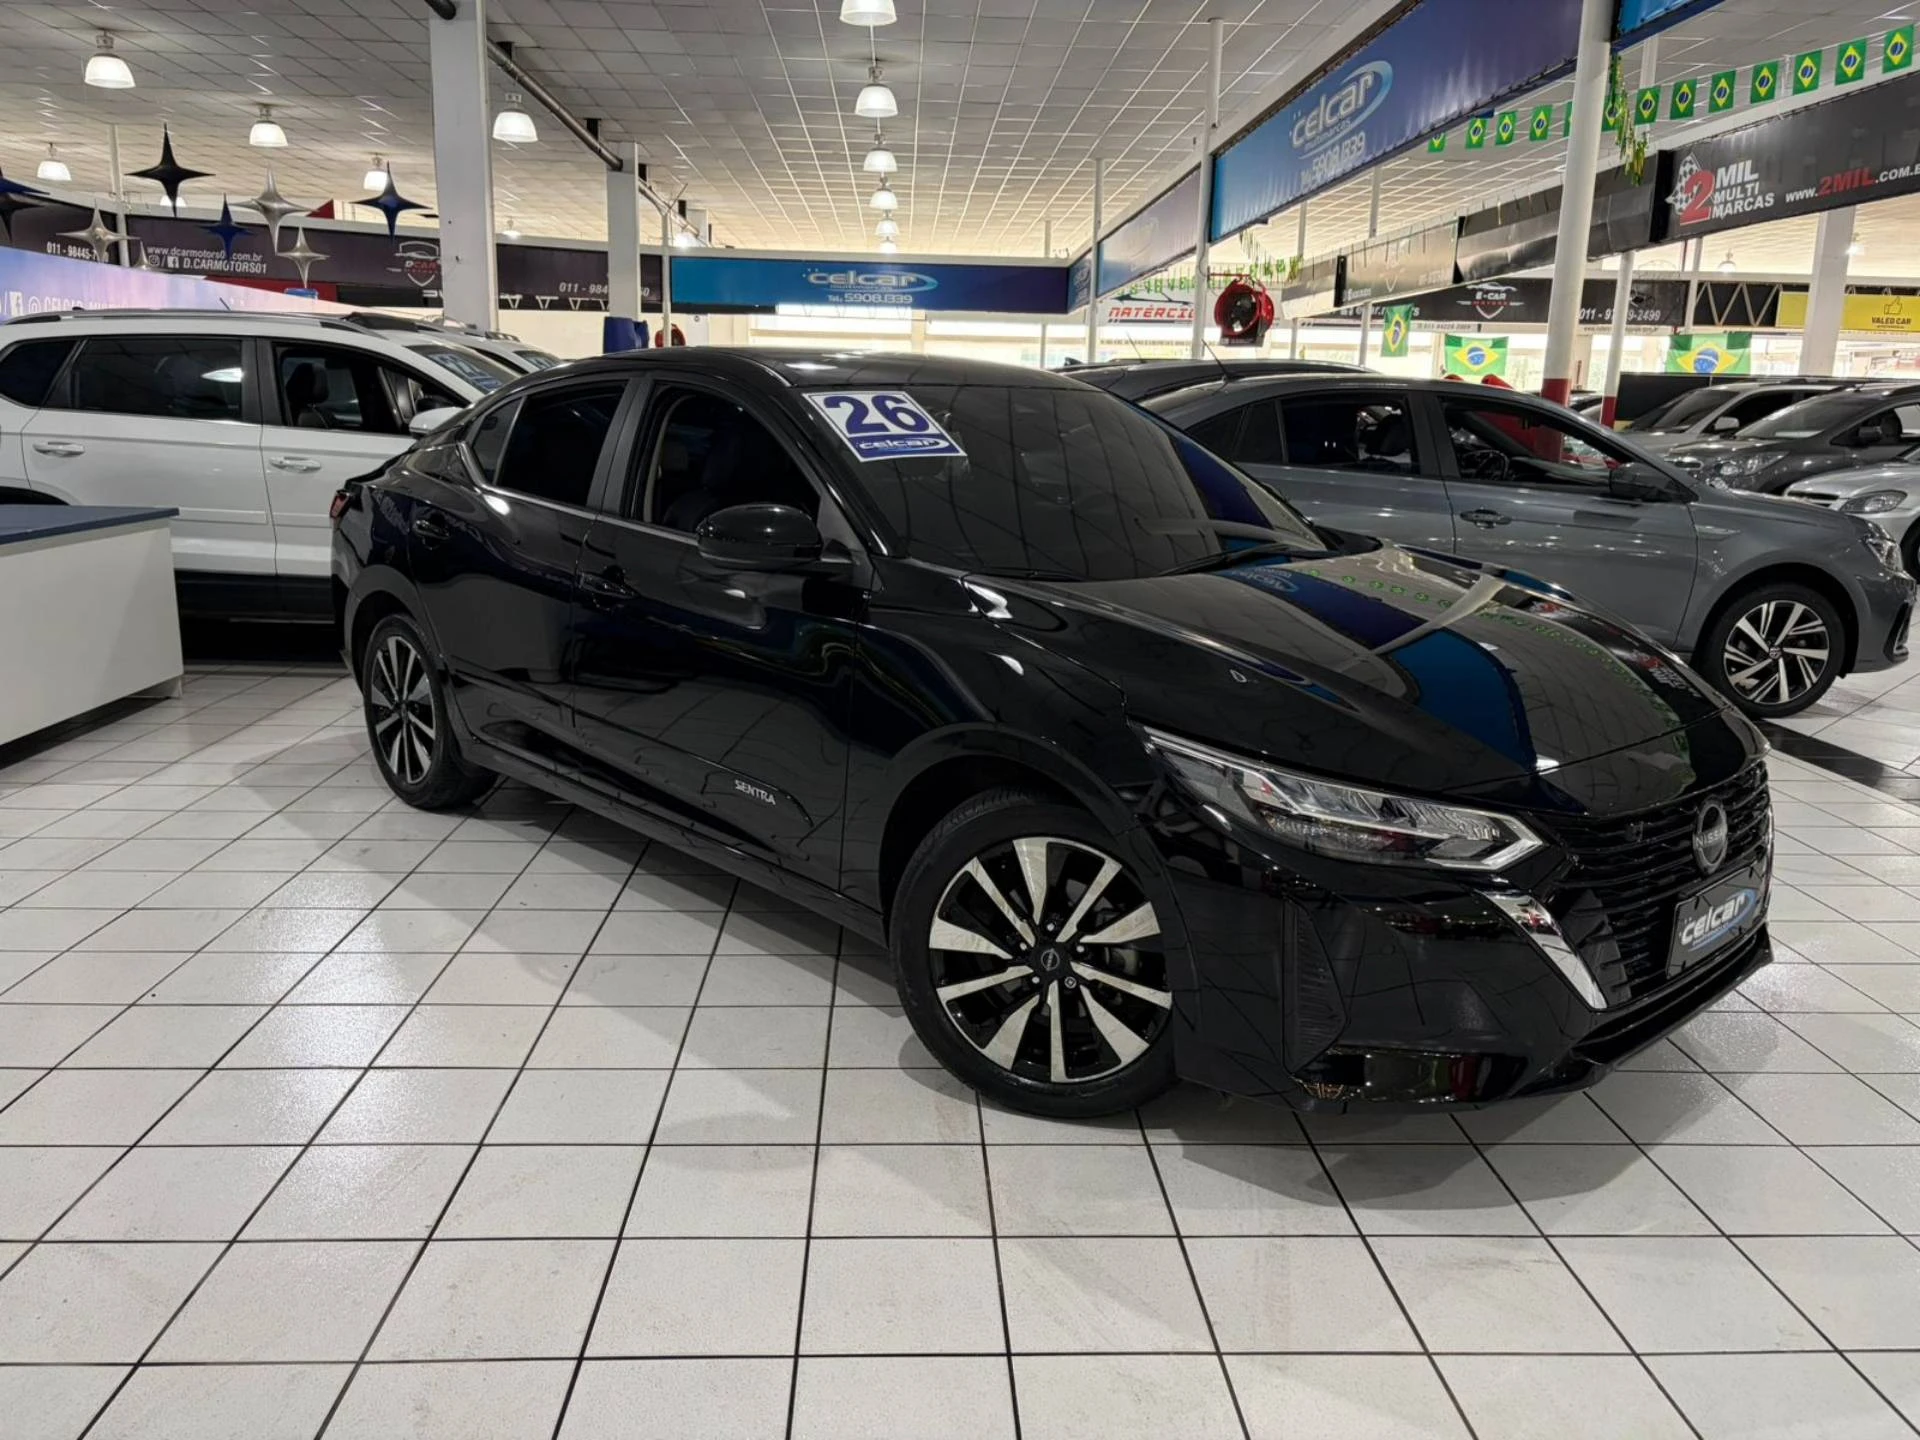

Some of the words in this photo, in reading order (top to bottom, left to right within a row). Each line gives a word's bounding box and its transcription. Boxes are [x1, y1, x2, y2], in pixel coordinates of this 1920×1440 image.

[1292, 71, 1375, 148] celcar
[1680, 170, 1715, 226] 2
[1715, 160, 1759, 188] MIL
[1713, 182, 1759, 205] MULTI
[1712, 193, 1775, 219] MARCAS
[147, 246, 262, 261] www.dcarmotors0.com.br
[559, 282, 578, 293] 011
[808, 271, 917, 287] celcar
[1475, 291, 1507, 300] E-CAR
[1579, 308, 1596, 319] 011
[824, 395, 930, 434] 26
[859, 439, 939, 450] celcar
[735, 779, 776, 805] SENTRA
[1681, 891, 1746, 945] celcar
